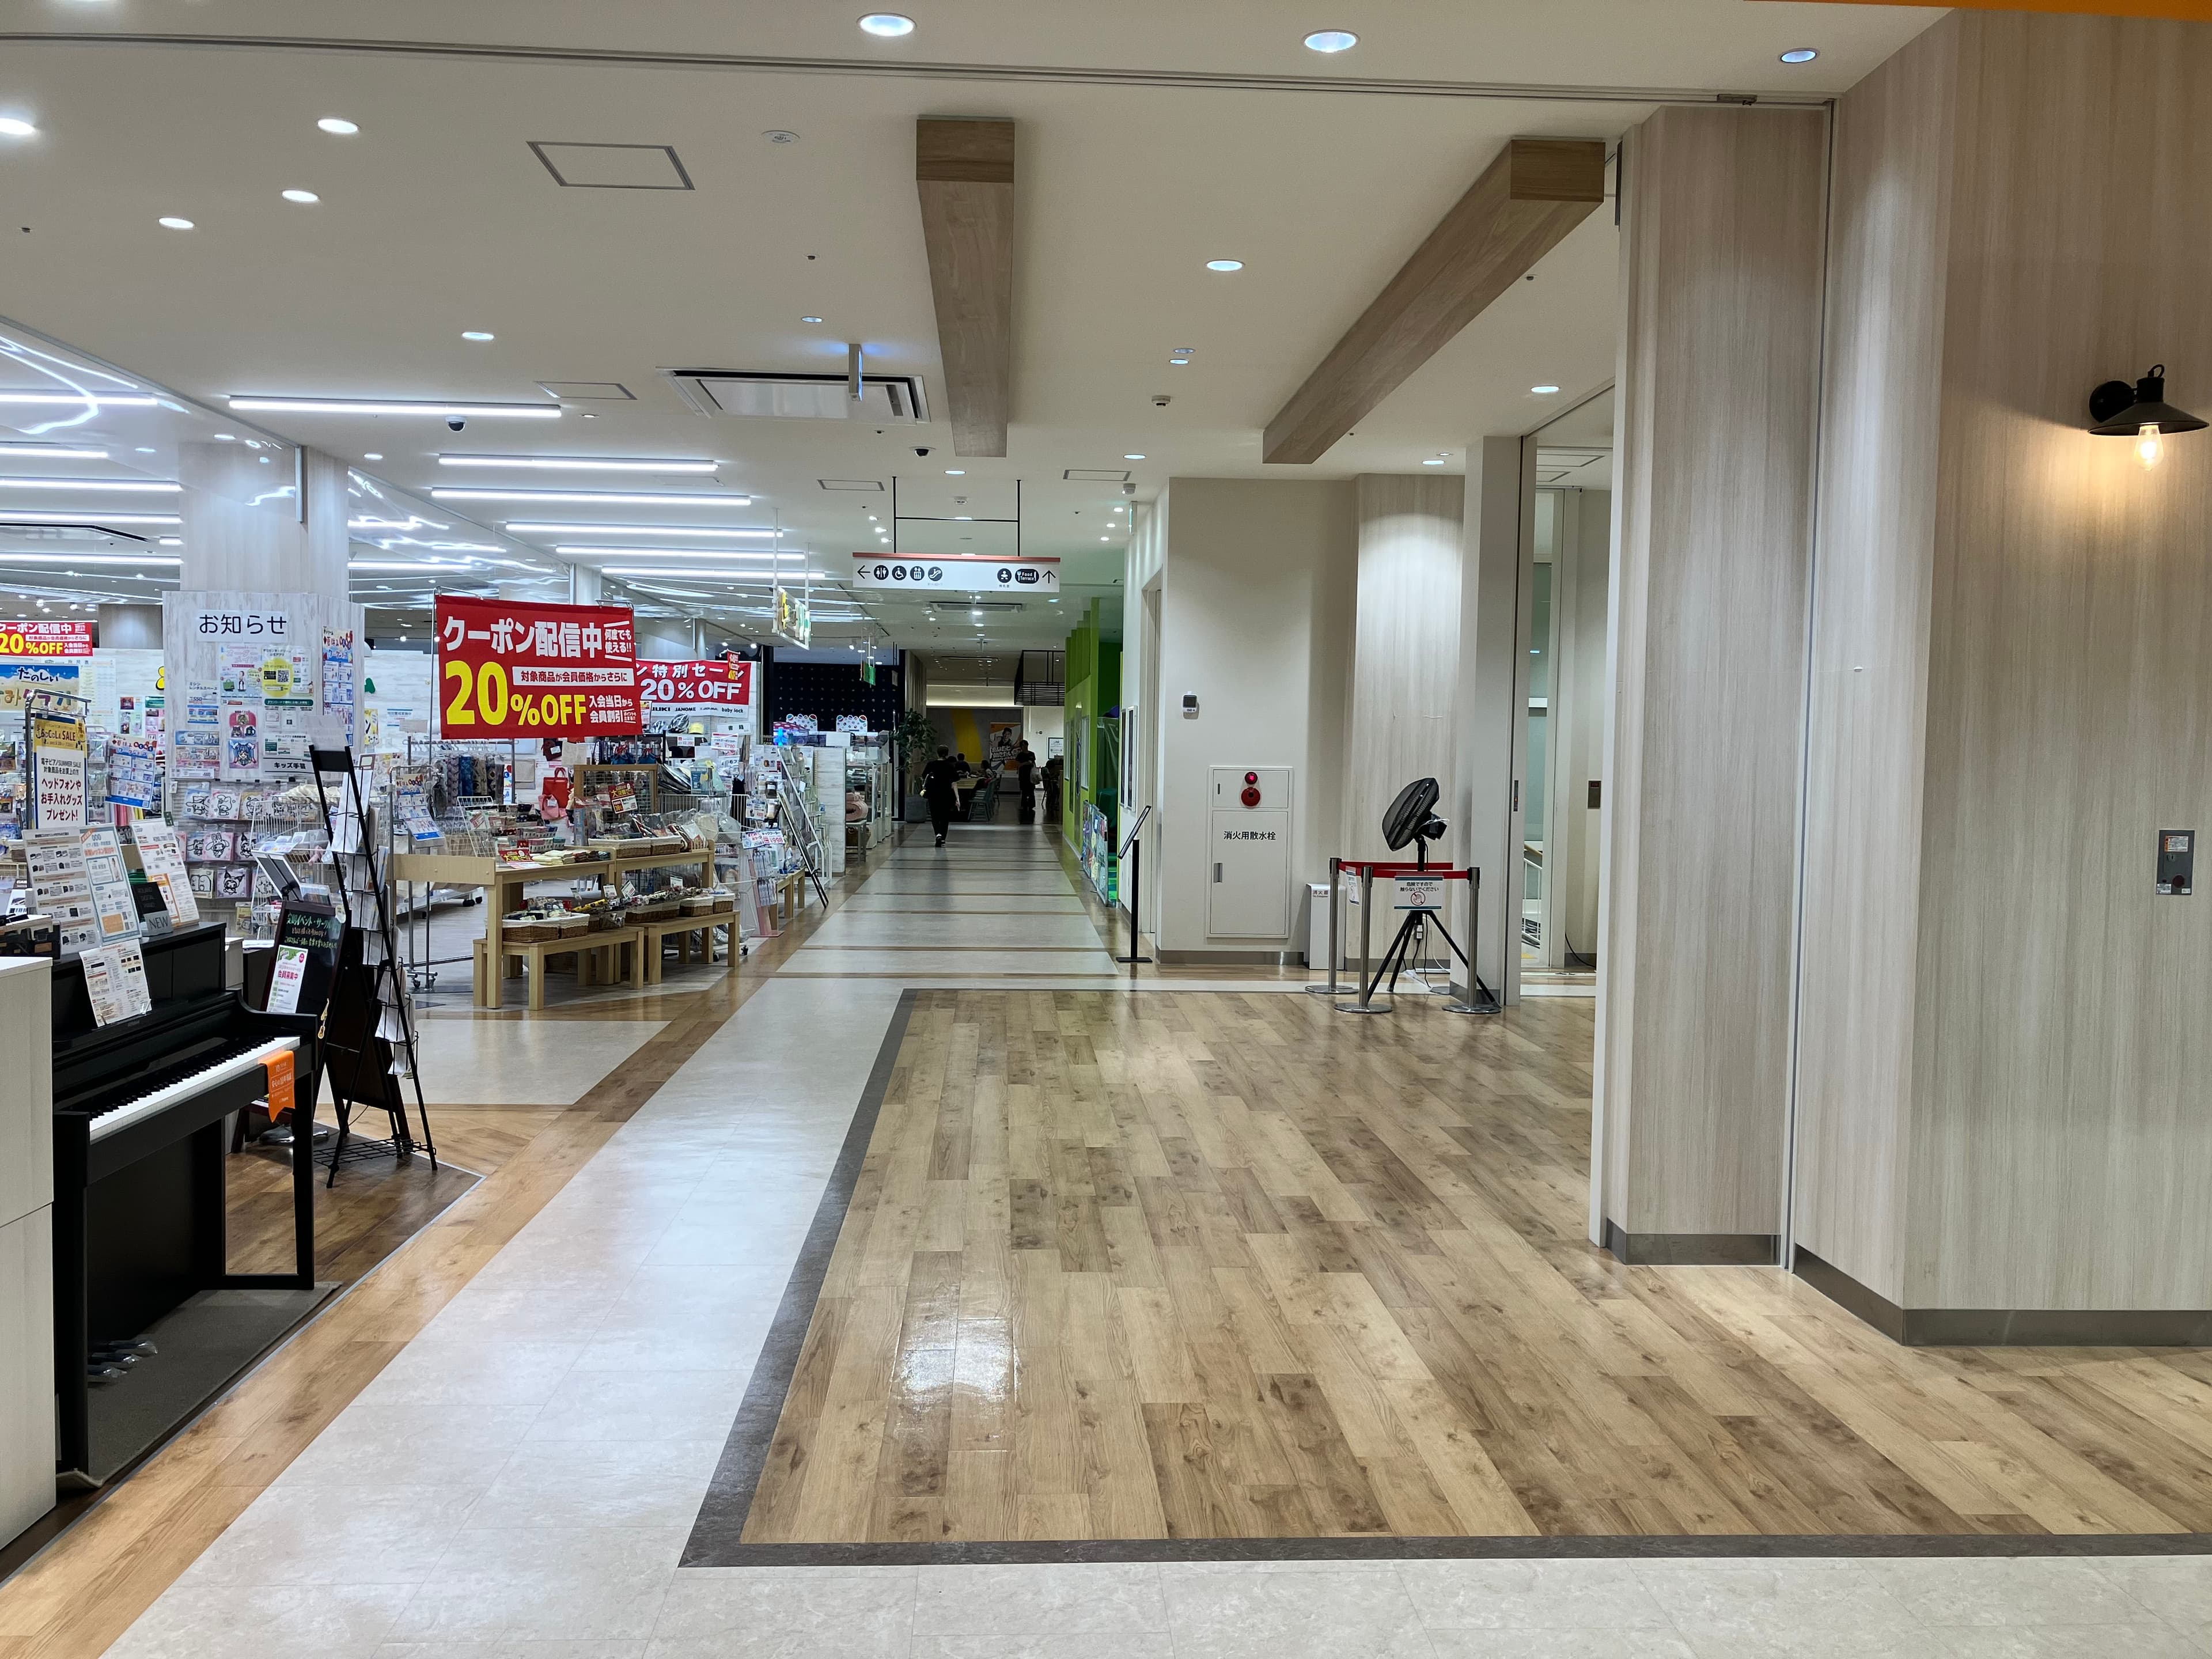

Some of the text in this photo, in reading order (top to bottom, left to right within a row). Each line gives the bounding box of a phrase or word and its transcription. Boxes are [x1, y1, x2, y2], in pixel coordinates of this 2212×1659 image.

[199, 613, 287, 635] お知らせ
[444, 616, 603, 658] クーポン配信中
[604, 628, 631, 641] 何度でも
[0, 633, 63, 654] 20%OFF
[604, 641, 632, 654] 使える!!
[17, 666, 59, 682] たのしい
[521, 669, 628, 683] 対象商品が会員価格からさらに
[445, 660, 586, 726] 20%OFF
[589, 695, 633, 708] 入会当日から
[589, 710, 623, 724] 会員割引
[62, 730, 76, 741] SALE
[274, 762, 306, 770] キッズ手芸
[41, 778, 82, 791] ヘッドフォンや
[41, 793, 83, 806] お手入れグッズ
[46, 809, 78, 821] プレゼント!
[1224, 831, 1277, 840] 消火用散水栓
[148, 915, 169, 930] NEW
[277, 969, 298, 981] 会員募集中
